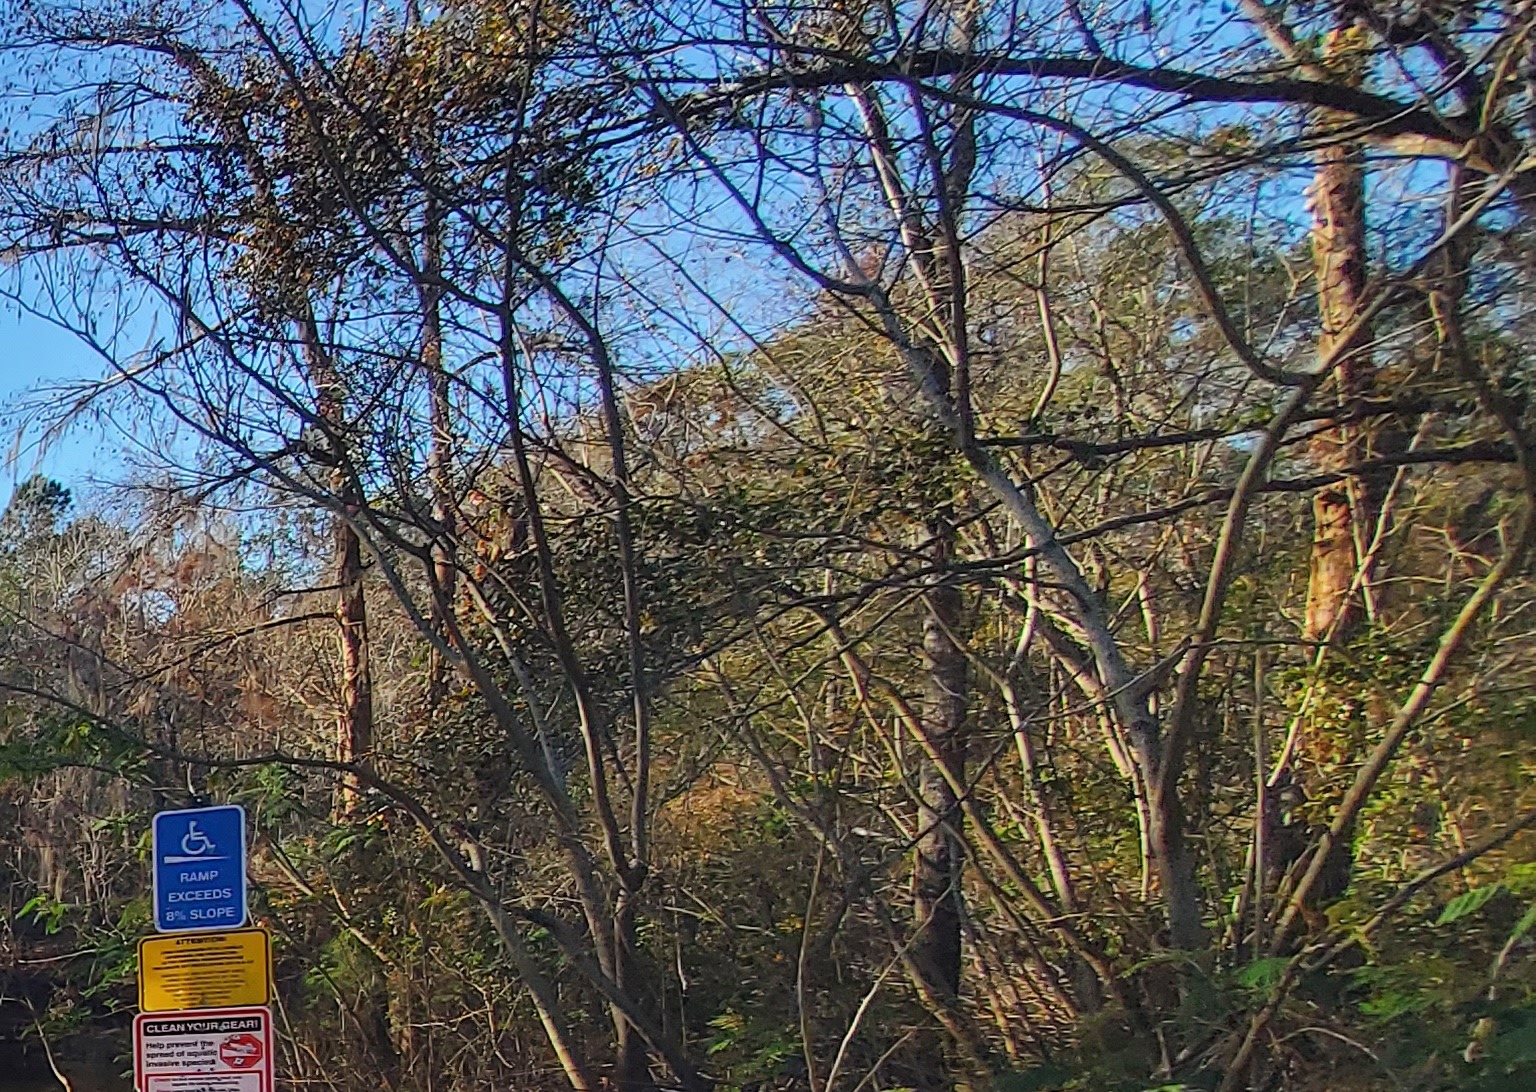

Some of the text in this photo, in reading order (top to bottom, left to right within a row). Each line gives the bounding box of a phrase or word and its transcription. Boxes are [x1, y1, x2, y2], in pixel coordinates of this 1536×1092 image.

[180, 870, 218, 882] RAMP
[168, 888, 232, 902] EXCEEDS
[165, 906, 236, 921] 8% SLOPE
[146, 1019, 259, 1033] CLEAN YOUR GEAR!
[166, 1040, 197, 1049] prevent
[146, 1051, 174, 1059] spread
[186, 1050, 217, 1058] aquatic
